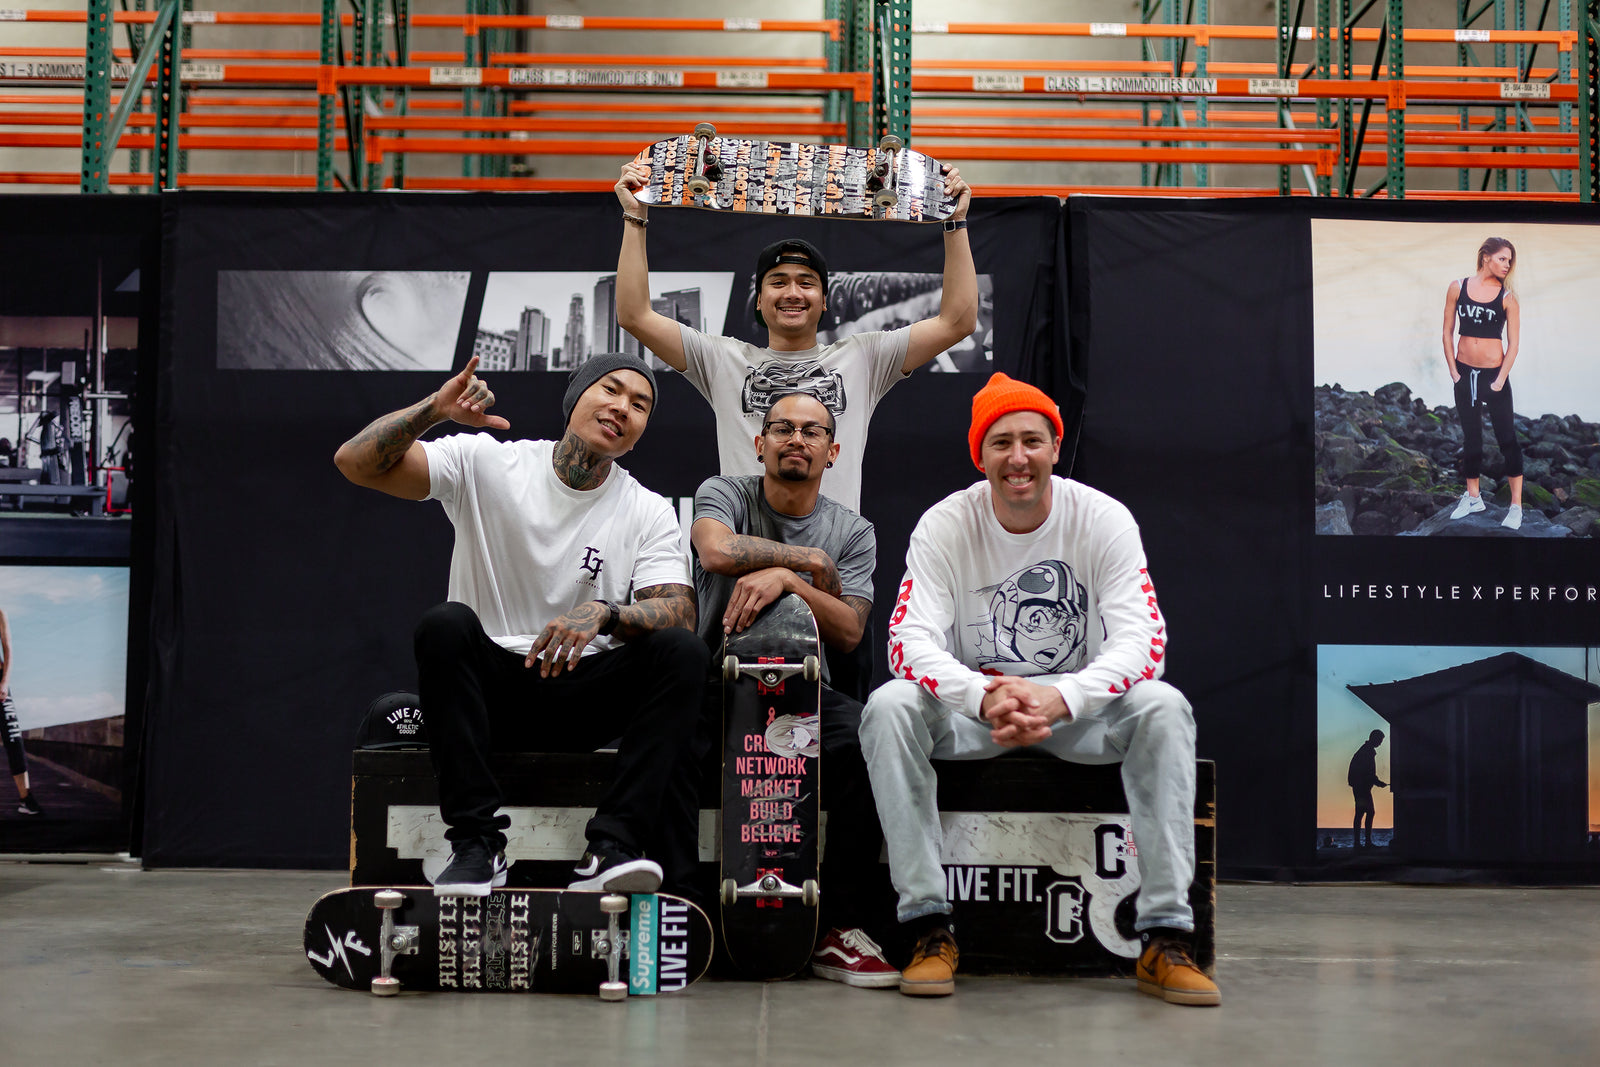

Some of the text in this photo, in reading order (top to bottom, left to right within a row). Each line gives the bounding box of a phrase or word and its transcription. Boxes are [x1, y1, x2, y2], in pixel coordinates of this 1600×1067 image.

[511, 69, 545, 83] CLASS
[1048, 77, 1080, 91] CLASS
[1111, 78, 1183, 92] COMMODITIES
[1187, 79, 1215, 93] ONLY
[662, 138, 678, 203] BLACK ROCK
[672, 135, 688, 205] BROWN MARBLE
[720, 138, 738, 165] BANKS
[733, 140, 752, 211] BLOOD BANKS
[747, 140, 768, 212] PIER SEVEN
[762, 142, 781, 213] FORT MILEY
[777, 143, 799, 214] SEA WALL
[795, 144, 815, 215] BAY BLOCKS
[826, 145, 847, 214] 3 UP 3 DOWN
[843, 148, 867, 214] WALLENBERG
[910, 198, 923, 221] SAN
[1324, 584, 1597, 601] LIFESTYLE X PERFOR
[386, 707, 410, 724] LIVE
[744, 734, 771, 753] CRE
[736, 757, 807, 775] NETWORK
[741, 779, 802, 798] MARKET
[741, 824, 801, 843] BELIEVE
[750, 801, 793, 820] BUILD
[948, 867, 1042, 902] IVE FIT.
[439, 896, 458, 988] HUSTLE
[510, 893, 530, 990] HUSTLE
[632, 900, 654, 989] Supreme
[660, 901, 688, 992] LIVE FIT
